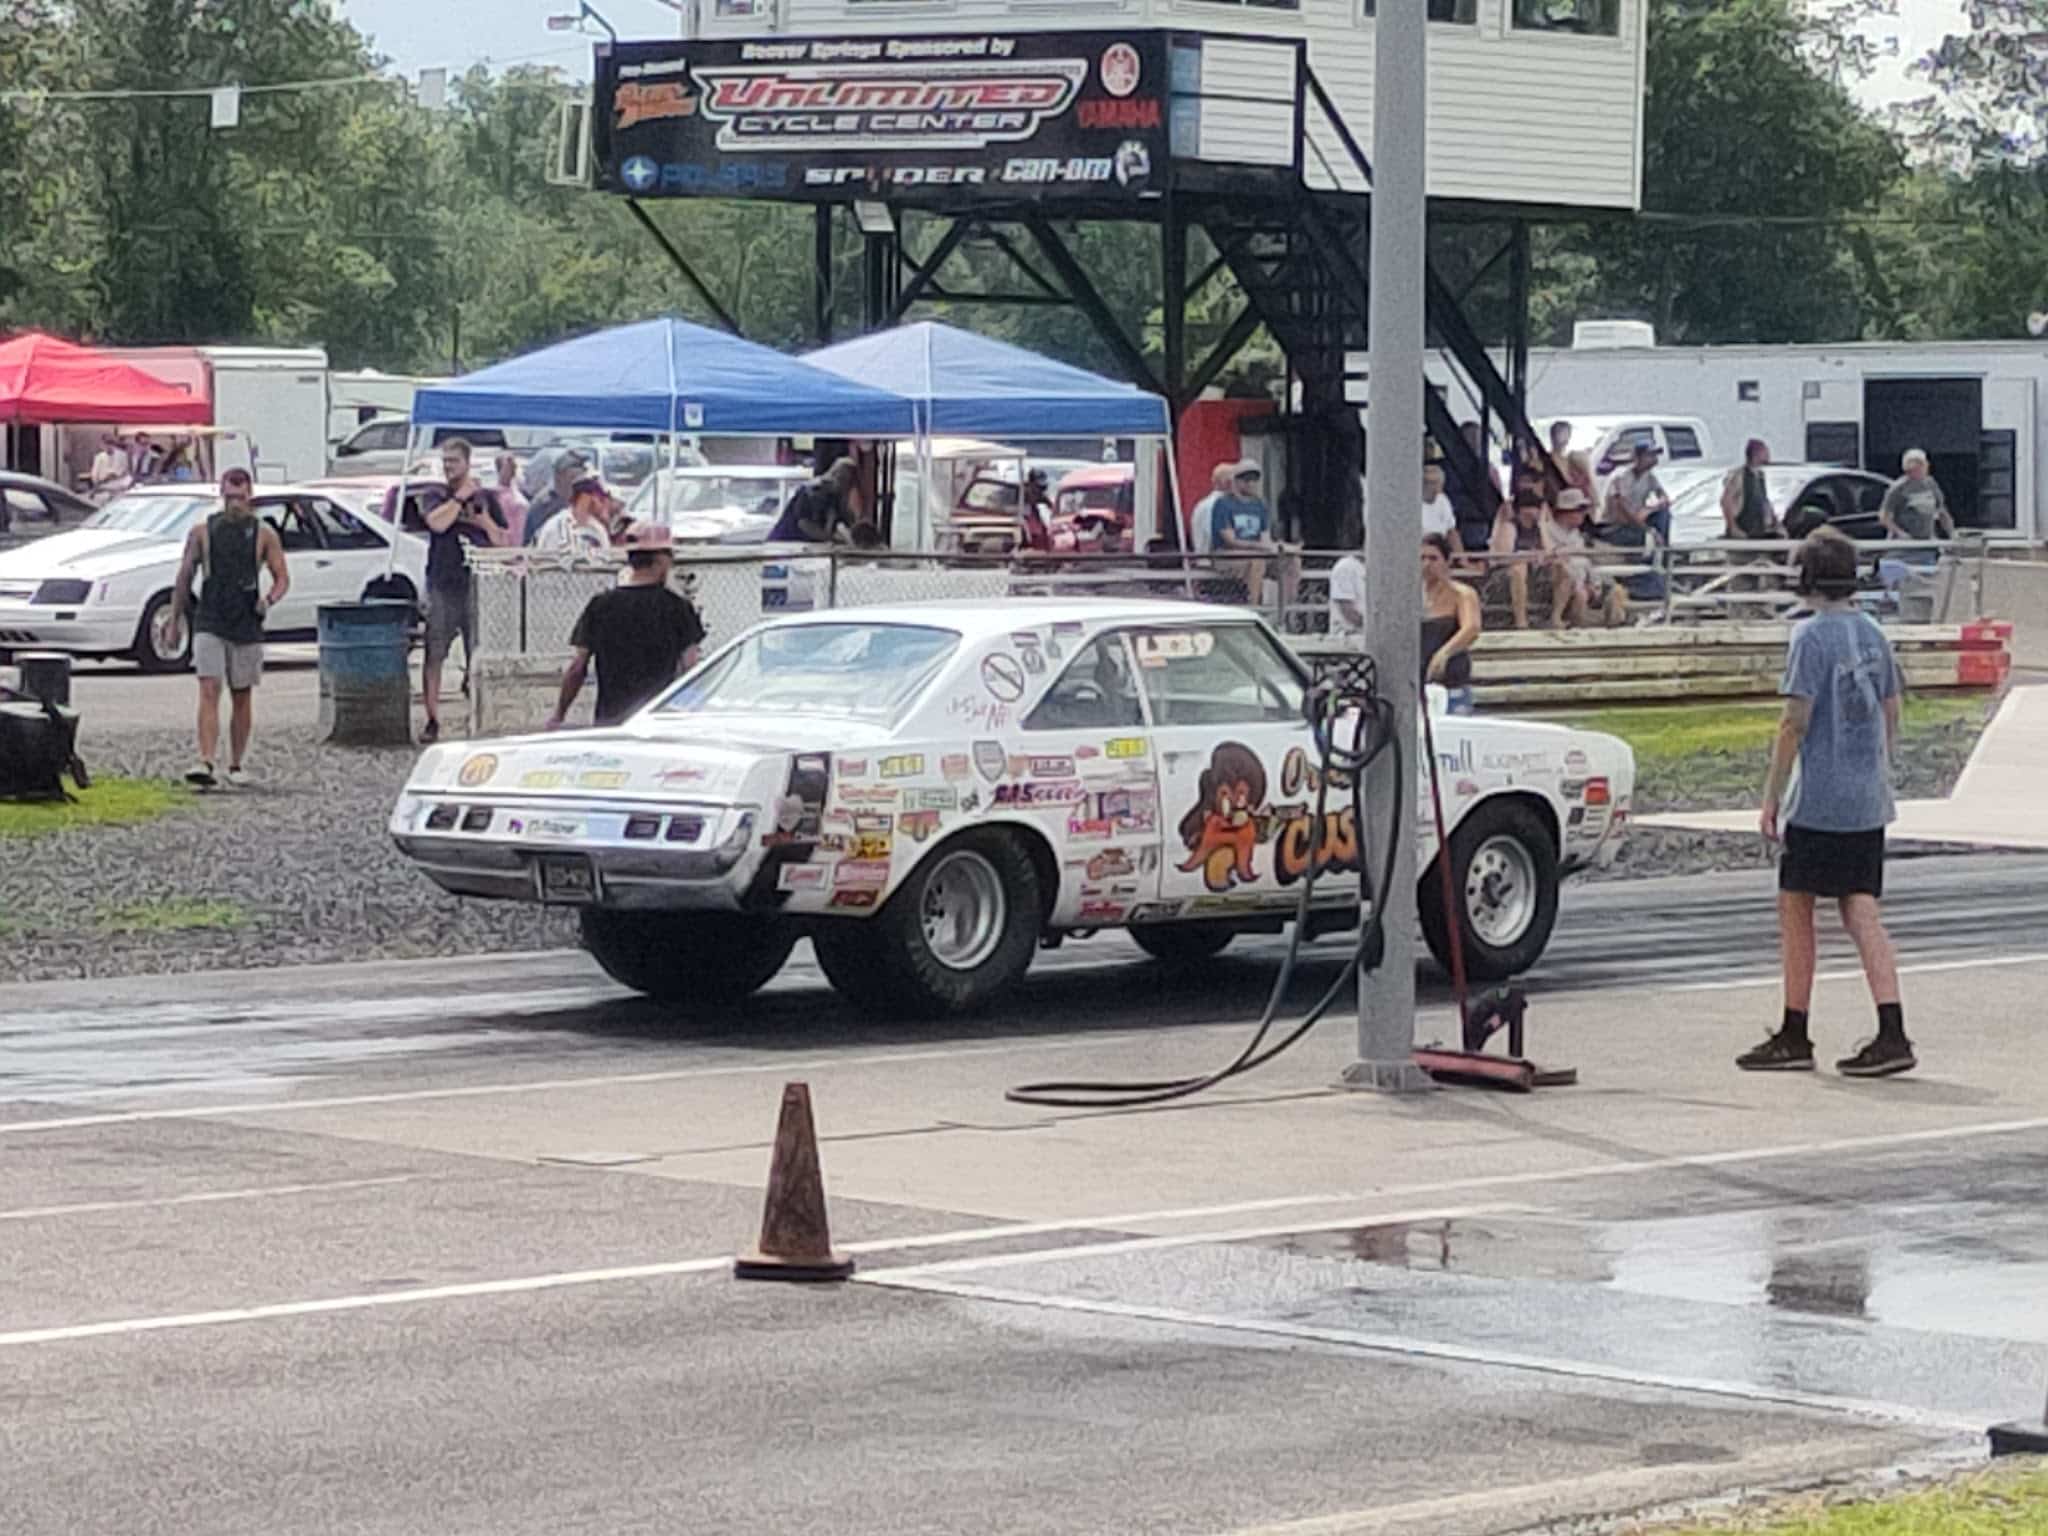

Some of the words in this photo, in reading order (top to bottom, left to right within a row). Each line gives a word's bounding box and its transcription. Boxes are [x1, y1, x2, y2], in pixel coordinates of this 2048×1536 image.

[990, 38, 1015, 57] by
[738, 115, 861, 132] CYCLE
[868, 113, 1026, 131] CENTER
